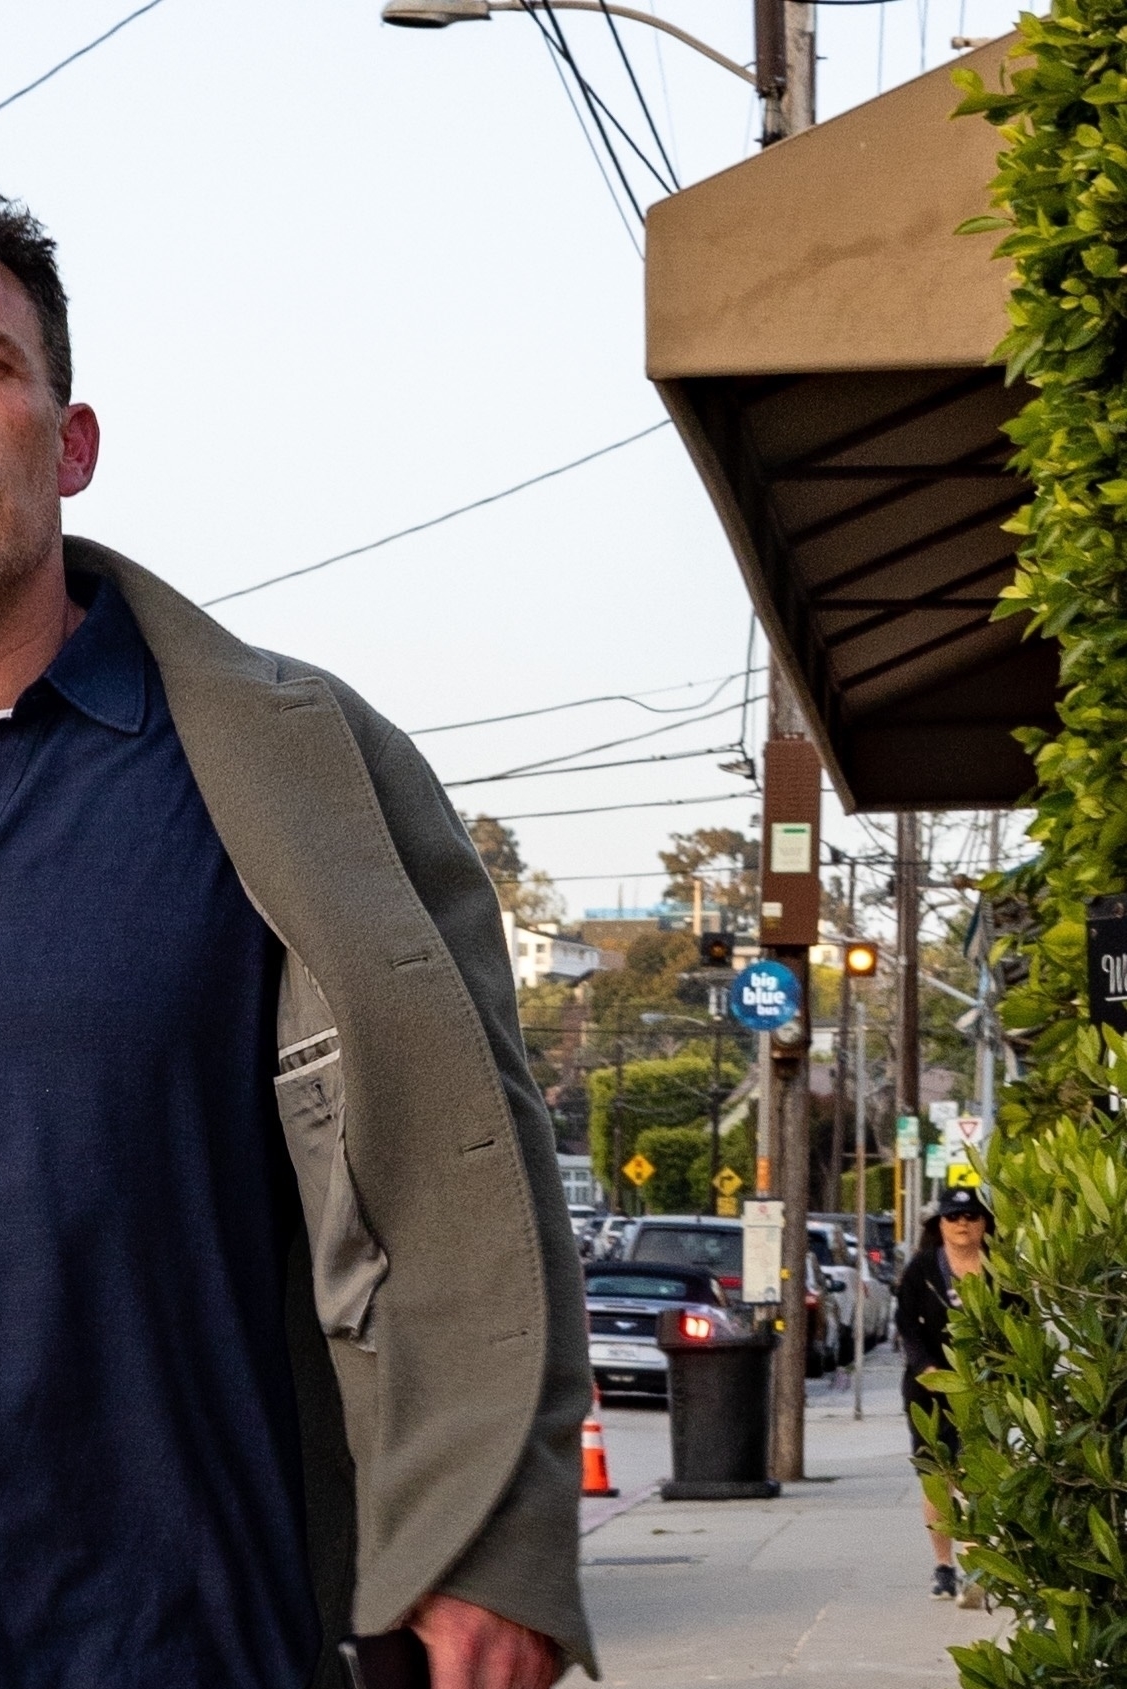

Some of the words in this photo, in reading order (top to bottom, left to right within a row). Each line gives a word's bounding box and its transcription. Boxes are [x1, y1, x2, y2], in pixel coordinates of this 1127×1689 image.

[751, 971, 778, 991] big
[742, 986, 786, 1005] blue
[756, 1003, 780, 1016] bus
